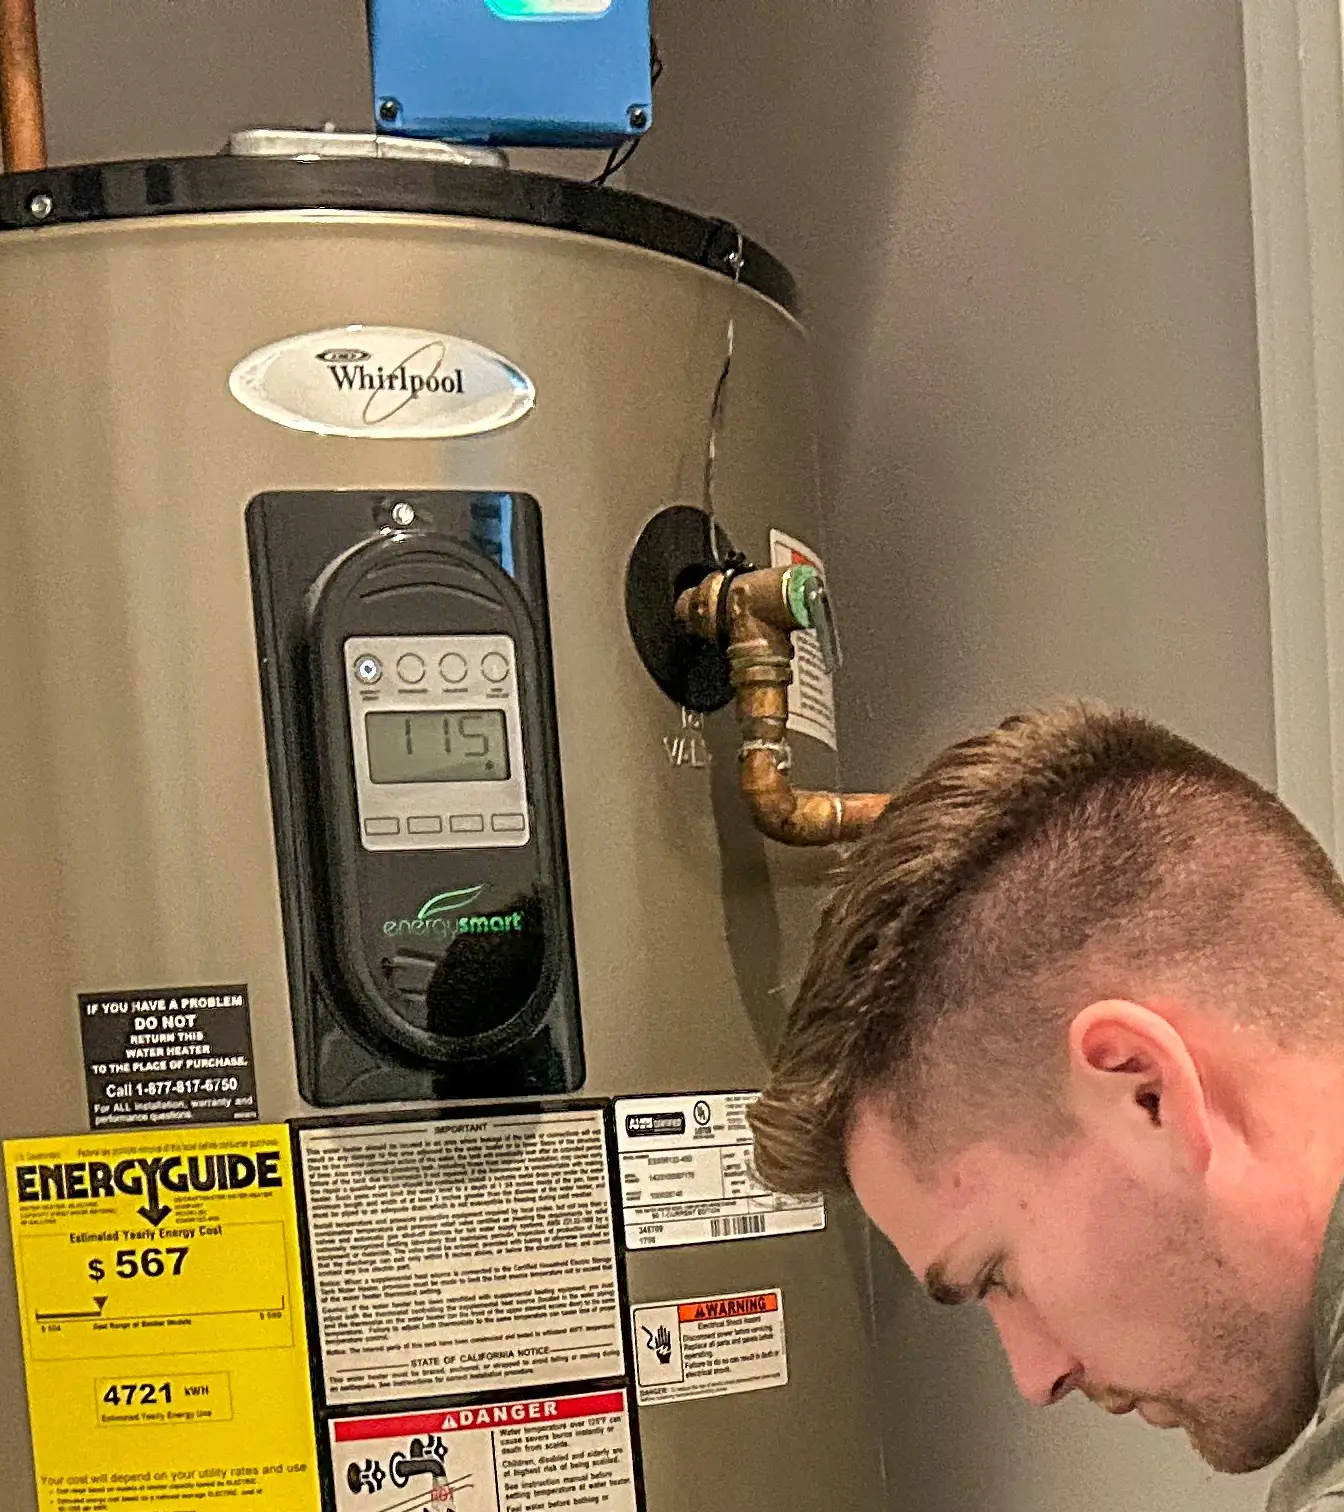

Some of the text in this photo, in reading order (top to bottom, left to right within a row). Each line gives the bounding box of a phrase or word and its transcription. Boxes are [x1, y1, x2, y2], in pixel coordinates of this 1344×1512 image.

[327, 364, 464, 399] Whirlpool
[405, 715, 489, 758] 115
[383, 912, 523, 938] energysmart
[87, 996, 242, 1014] IF YOU HAVE A PROBLEM
[134, 1014, 196, 1030] DO NOT
[130, 1032, 203, 1044] RETURN THIS
[126, 1045, 210, 1058] WATER HEATER
[92, 1064, 106, 1074] TO
[109, 1063, 130, 1073] THE
[132, 1061, 166, 1072] PLACE
[169, 1060, 183, 1070] OF
[106, 1084, 132, 1098] Call
[434, 1123, 487, 1134] IMPORTANT
[16, 1151, 283, 1203] ENERGYGUIDE
[69, 1225, 222, 1243] Estimated Yearly Energy Cost
[88, 1247, 189, 1283] $ 567
[706, 1297, 766, 1316] WARNING
[410, 1346, 549, 1367] STATE OF CALIFORNIA NOTICE
[104, 1382, 209, 1406] 4721 kWH
[459, 1402, 557, 1426] DANGER
[40, 1476, 64, 1486] Your
[67, 1474, 88, 1484] cost
[91, 1474, 108, 1483] will
[110, 1473, 150, 1485] depend
[154, 1472, 167, 1481] on
[172, 1471, 195, 1480] your
[198, 1468, 227, 1479] utility
[231, 1466, 259, 1476] rates
[262, 1464, 283, 1474] and
[286, 1464, 307, 1472] use
